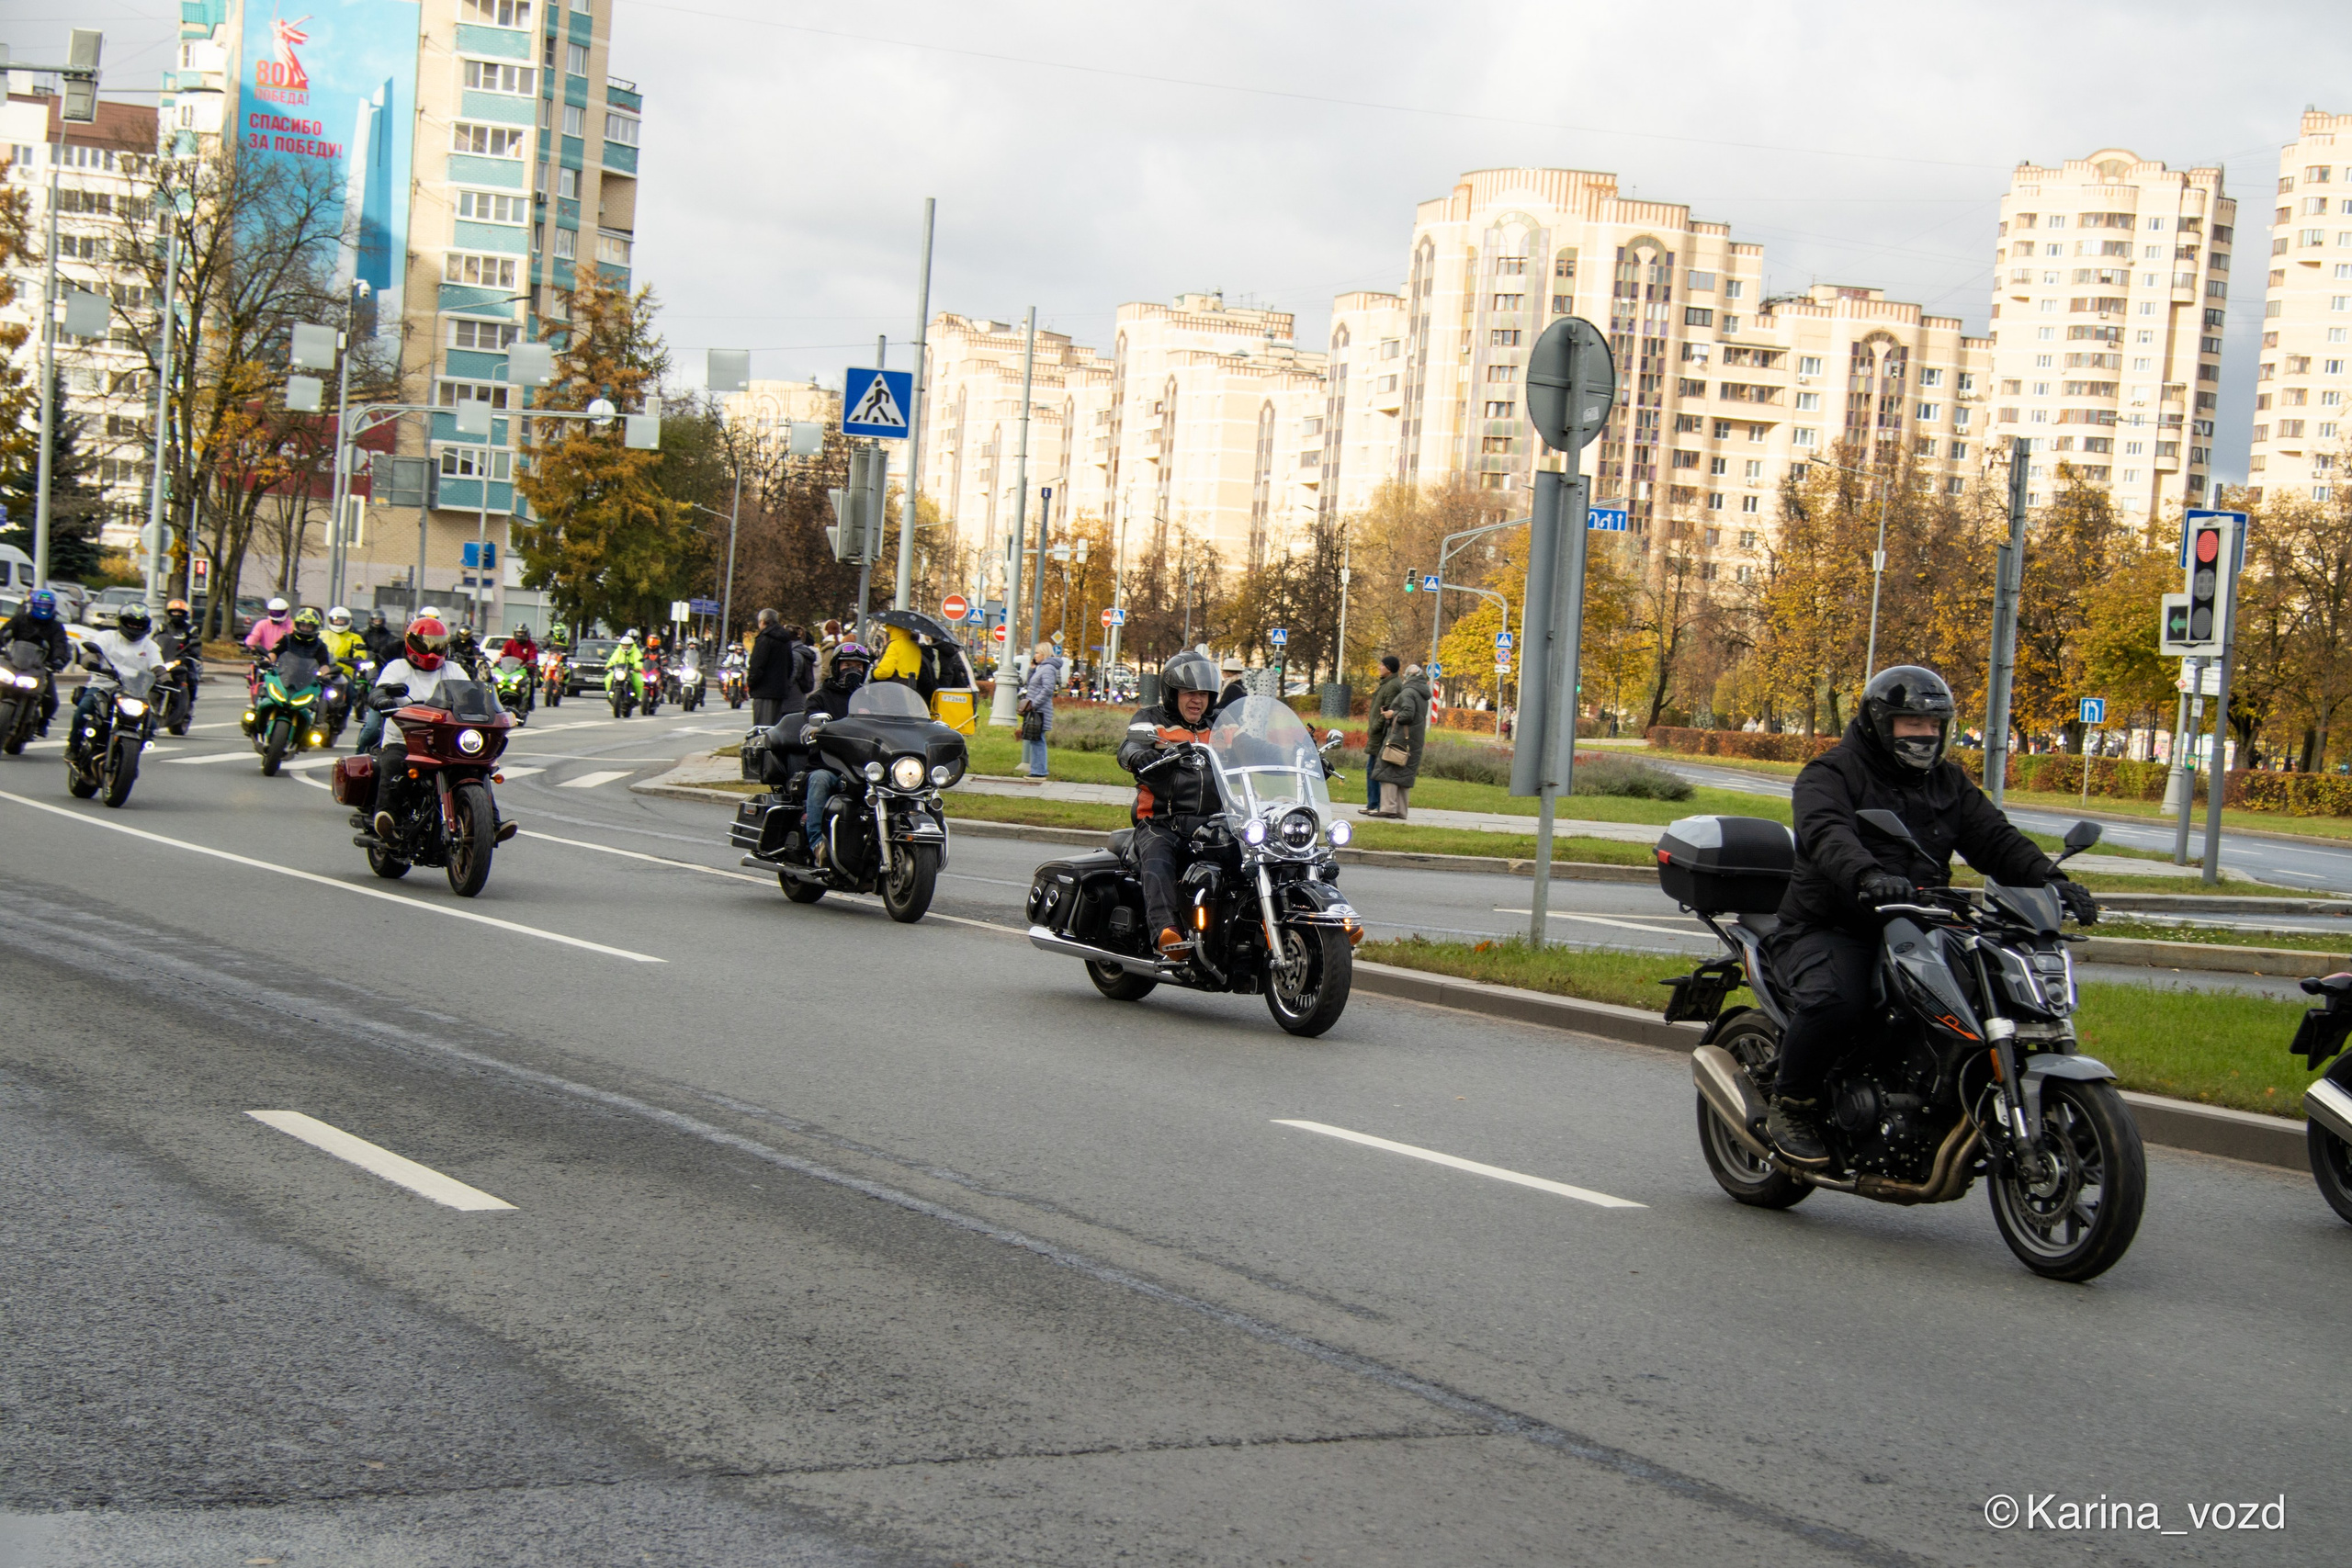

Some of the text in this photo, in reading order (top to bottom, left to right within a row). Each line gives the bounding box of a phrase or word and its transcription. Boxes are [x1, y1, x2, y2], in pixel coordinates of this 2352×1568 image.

[255, 60, 286, 85] 80
[254, 87, 310, 106] ПОБЕДА!
[249, 113, 322, 136] СПАСИБО
[248, 133, 343, 159] ЗА ПОБЕДУ!
